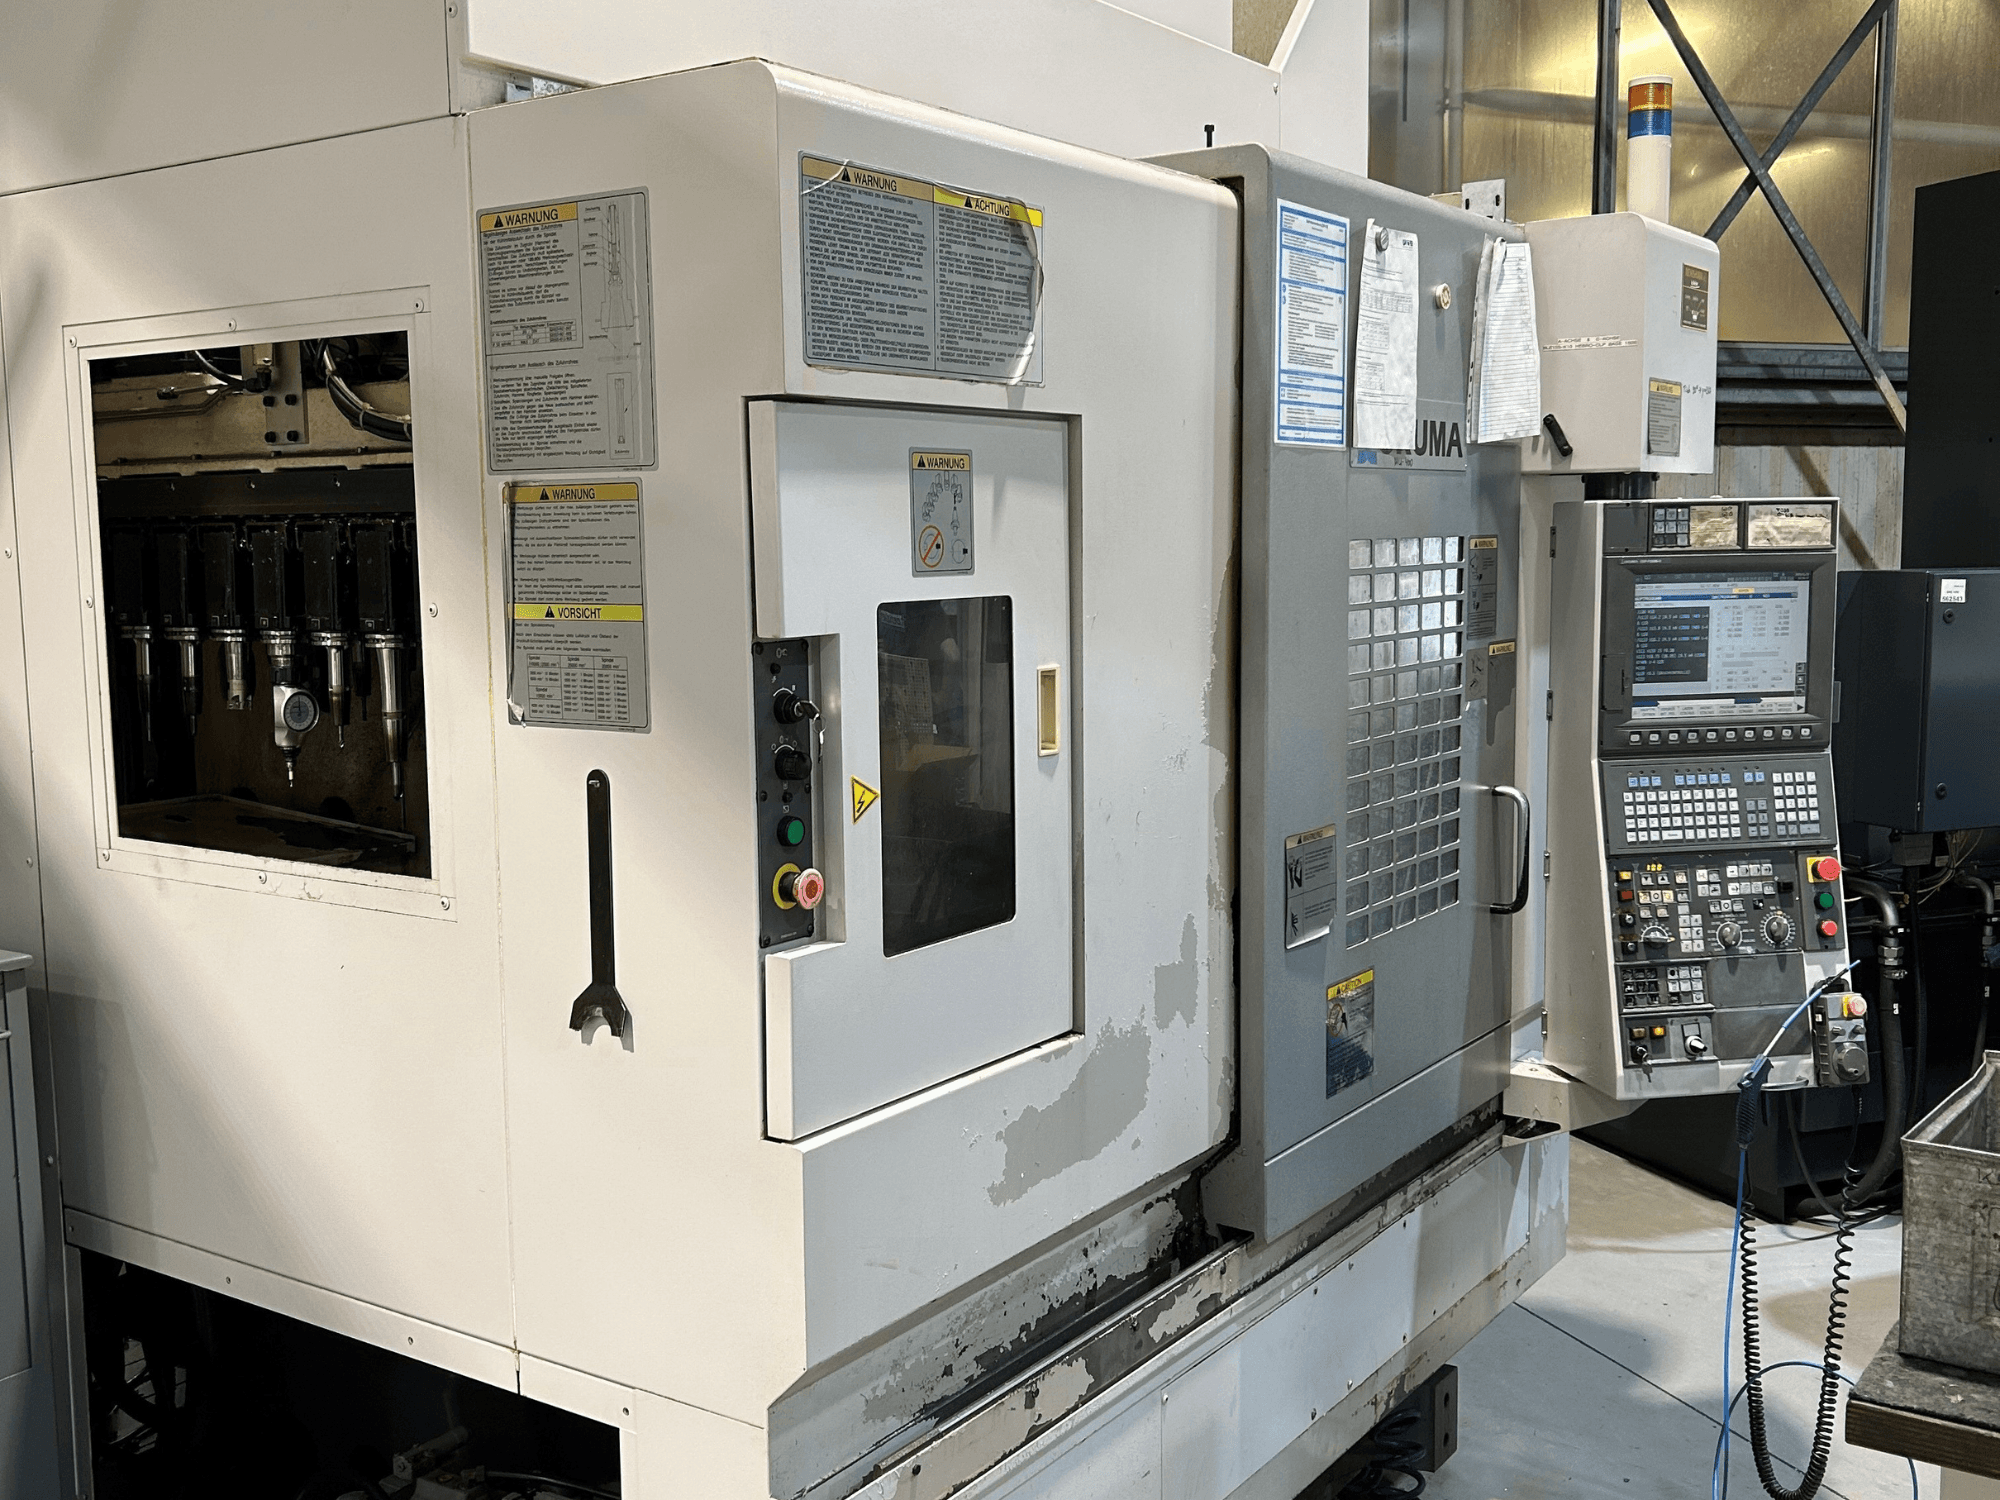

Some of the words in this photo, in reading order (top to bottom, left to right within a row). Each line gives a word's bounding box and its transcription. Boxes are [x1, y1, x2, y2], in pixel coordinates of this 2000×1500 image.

[853, 172, 898, 192] WARNUNG
[974, 199, 1010, 217] ACHTUNG
[505, 208, 559, 226] WARNUNG
[926, 457, 965, 469] WARNUNG
[552, 488, 595, 500] WARNUNG
[557, 607, 602, 619] VORSICHT
